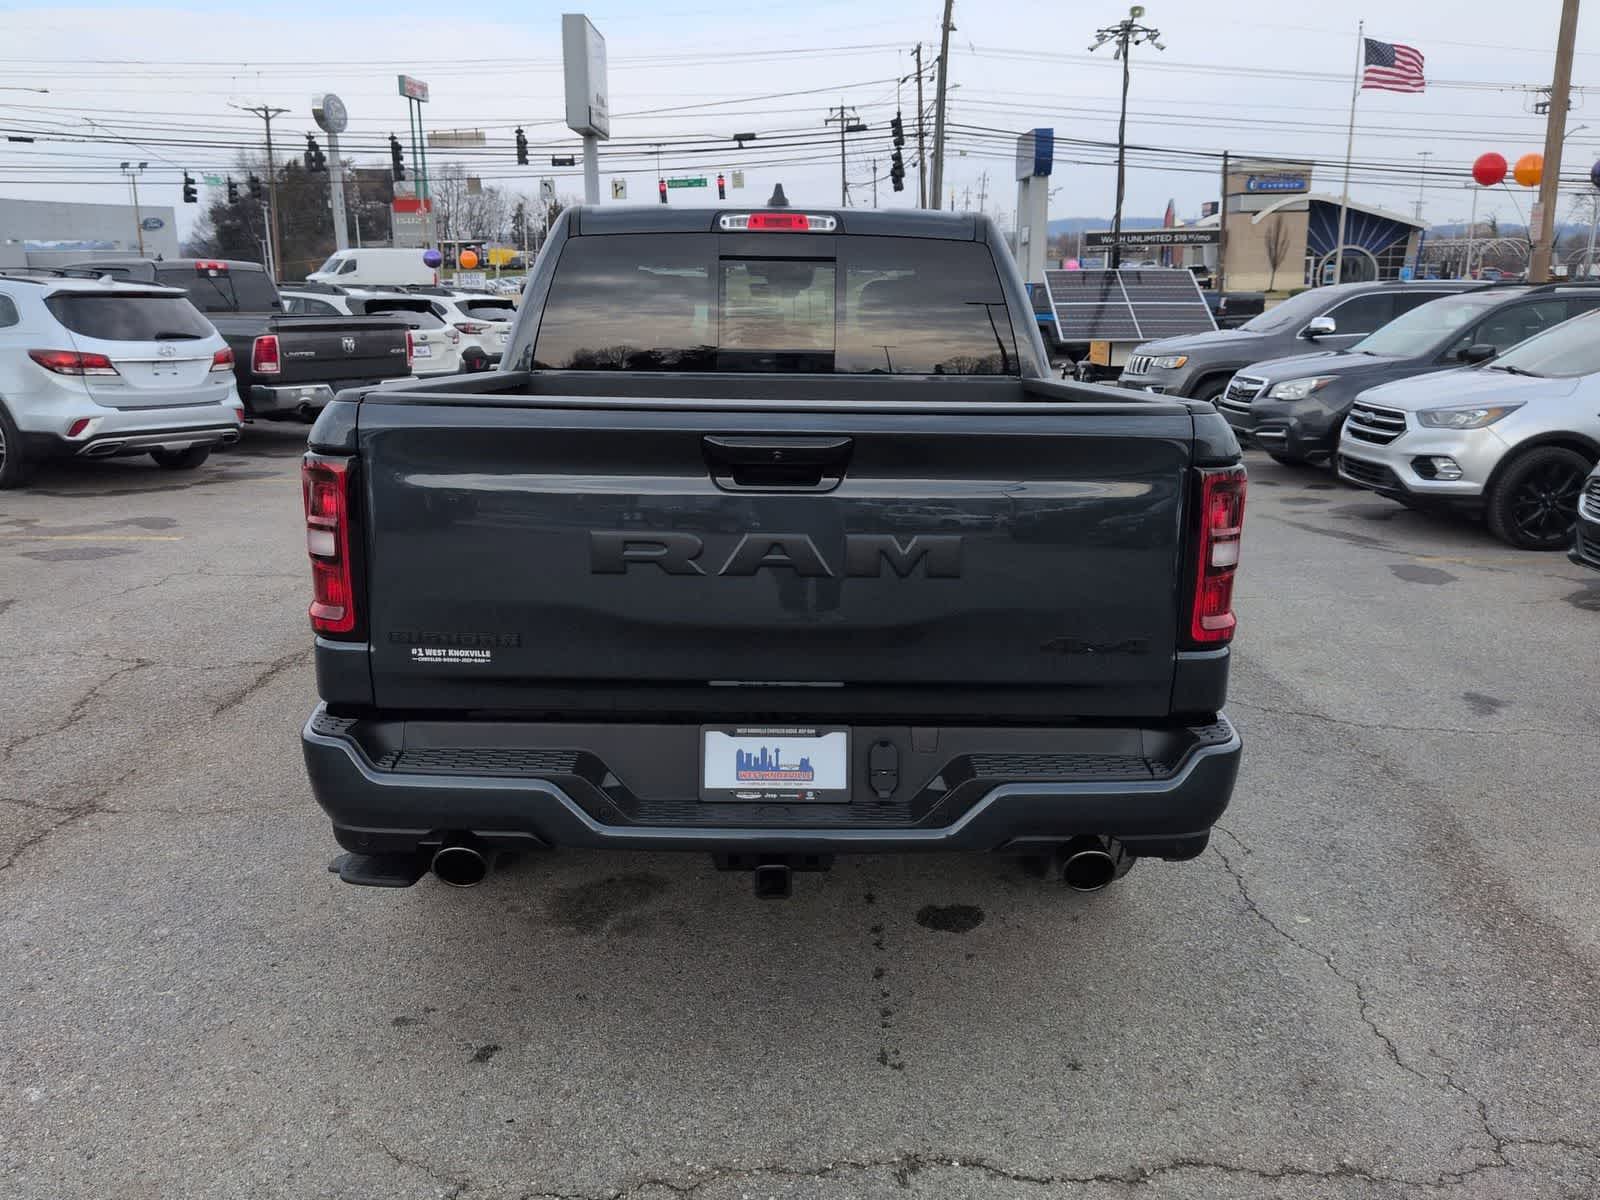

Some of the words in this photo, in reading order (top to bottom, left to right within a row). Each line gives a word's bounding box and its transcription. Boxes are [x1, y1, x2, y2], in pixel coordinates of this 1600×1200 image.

[1101, 234, 1127, 244] WAH
[1128, 234, 1171, 243] UNLIMITED
[589, 530, 964, 579] RAM
[411, 648, 424, 657] #1
[424, 648, 447, 657] WEST
[448, 649, 491, 658] KNOXVILLE
